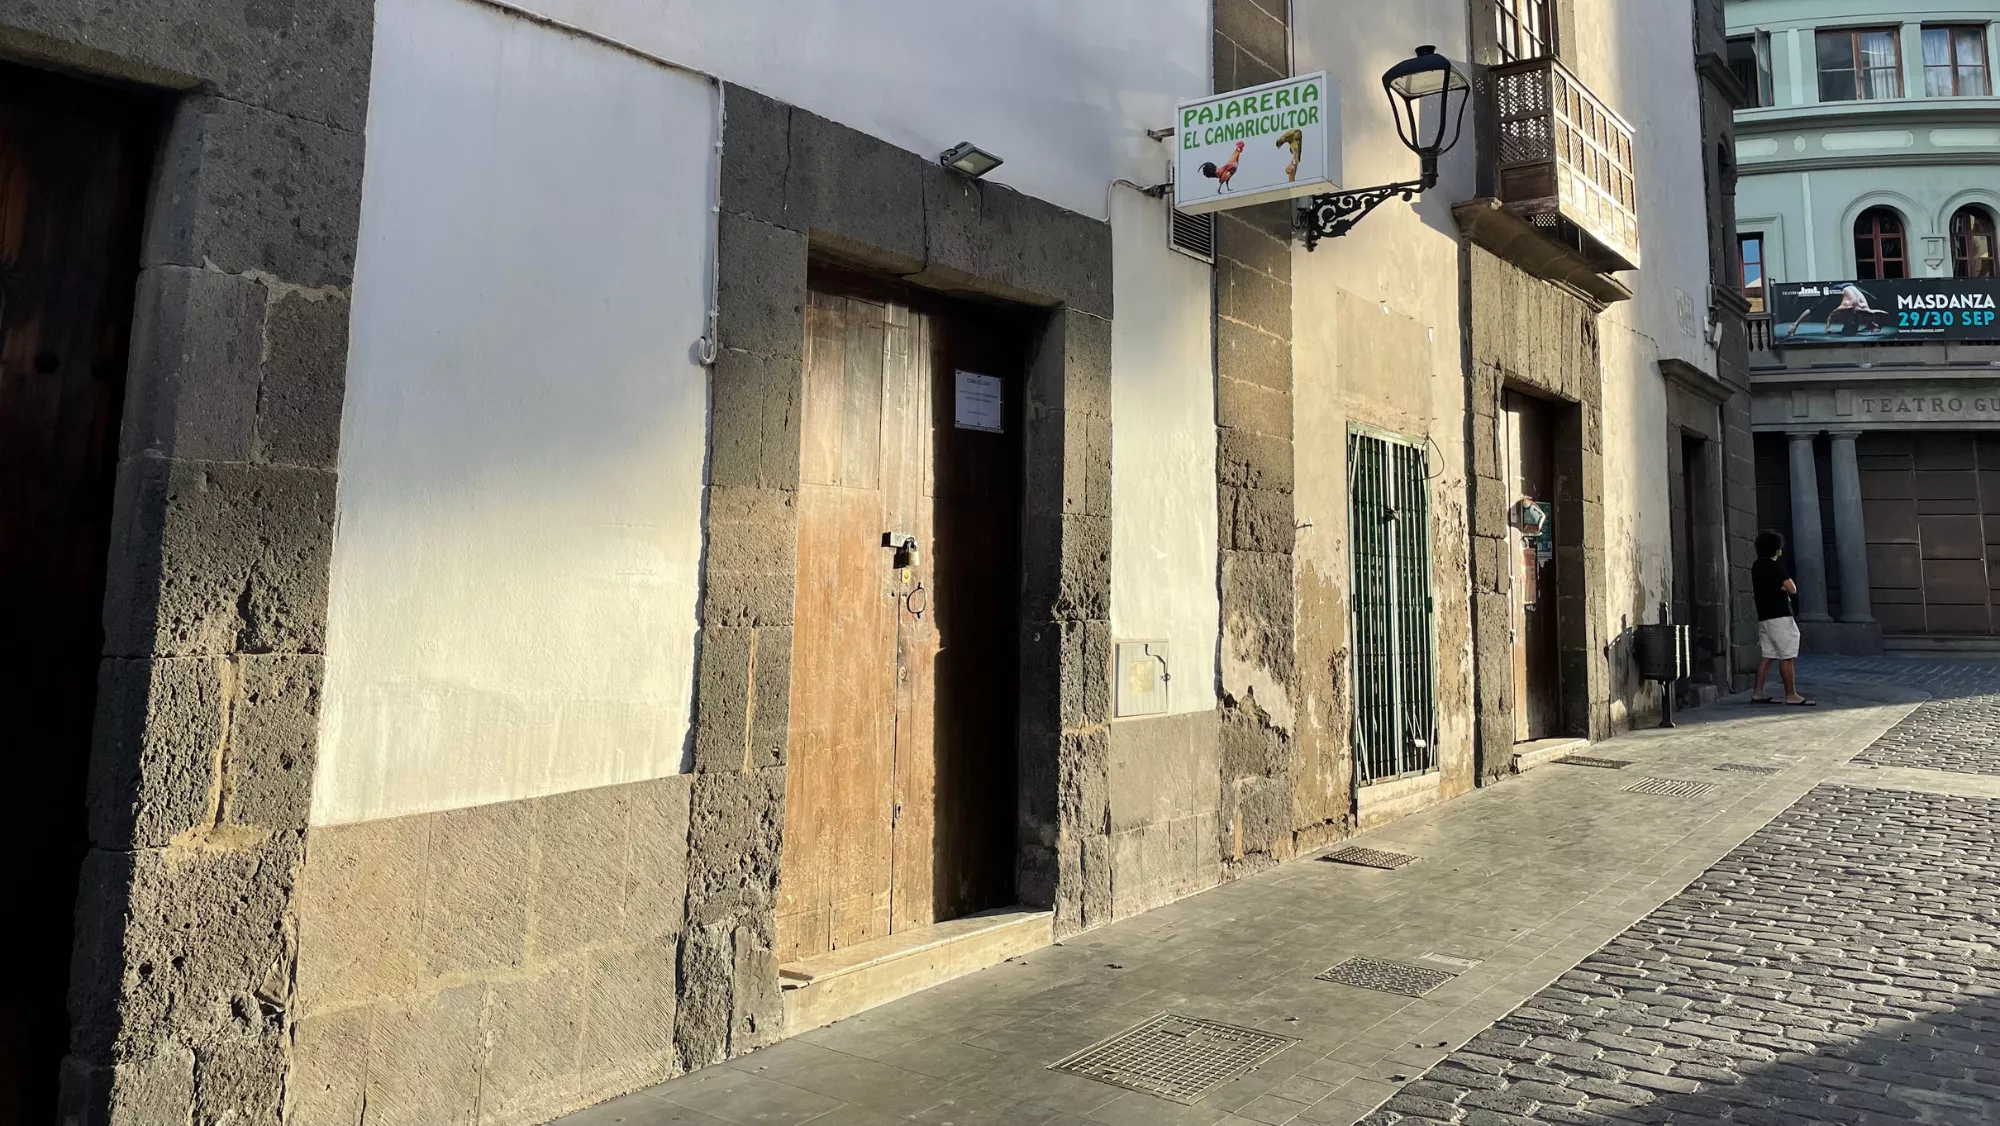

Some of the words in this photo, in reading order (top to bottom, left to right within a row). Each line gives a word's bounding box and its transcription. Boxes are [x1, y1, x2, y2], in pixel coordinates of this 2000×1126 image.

[1184, 83, 1319, 128] PAJARERIA
[1184, 130, 1200, 150] EL
[1204, 105, 1319, 146] CANARICULTOR
[1897, 293, 1996, 309] MASDANZA
[1898, 311, 1954, 327] 29/30
[1961, 311, 1995, 326] SEP
[1861, 397, 1963, 413] TEATRO
